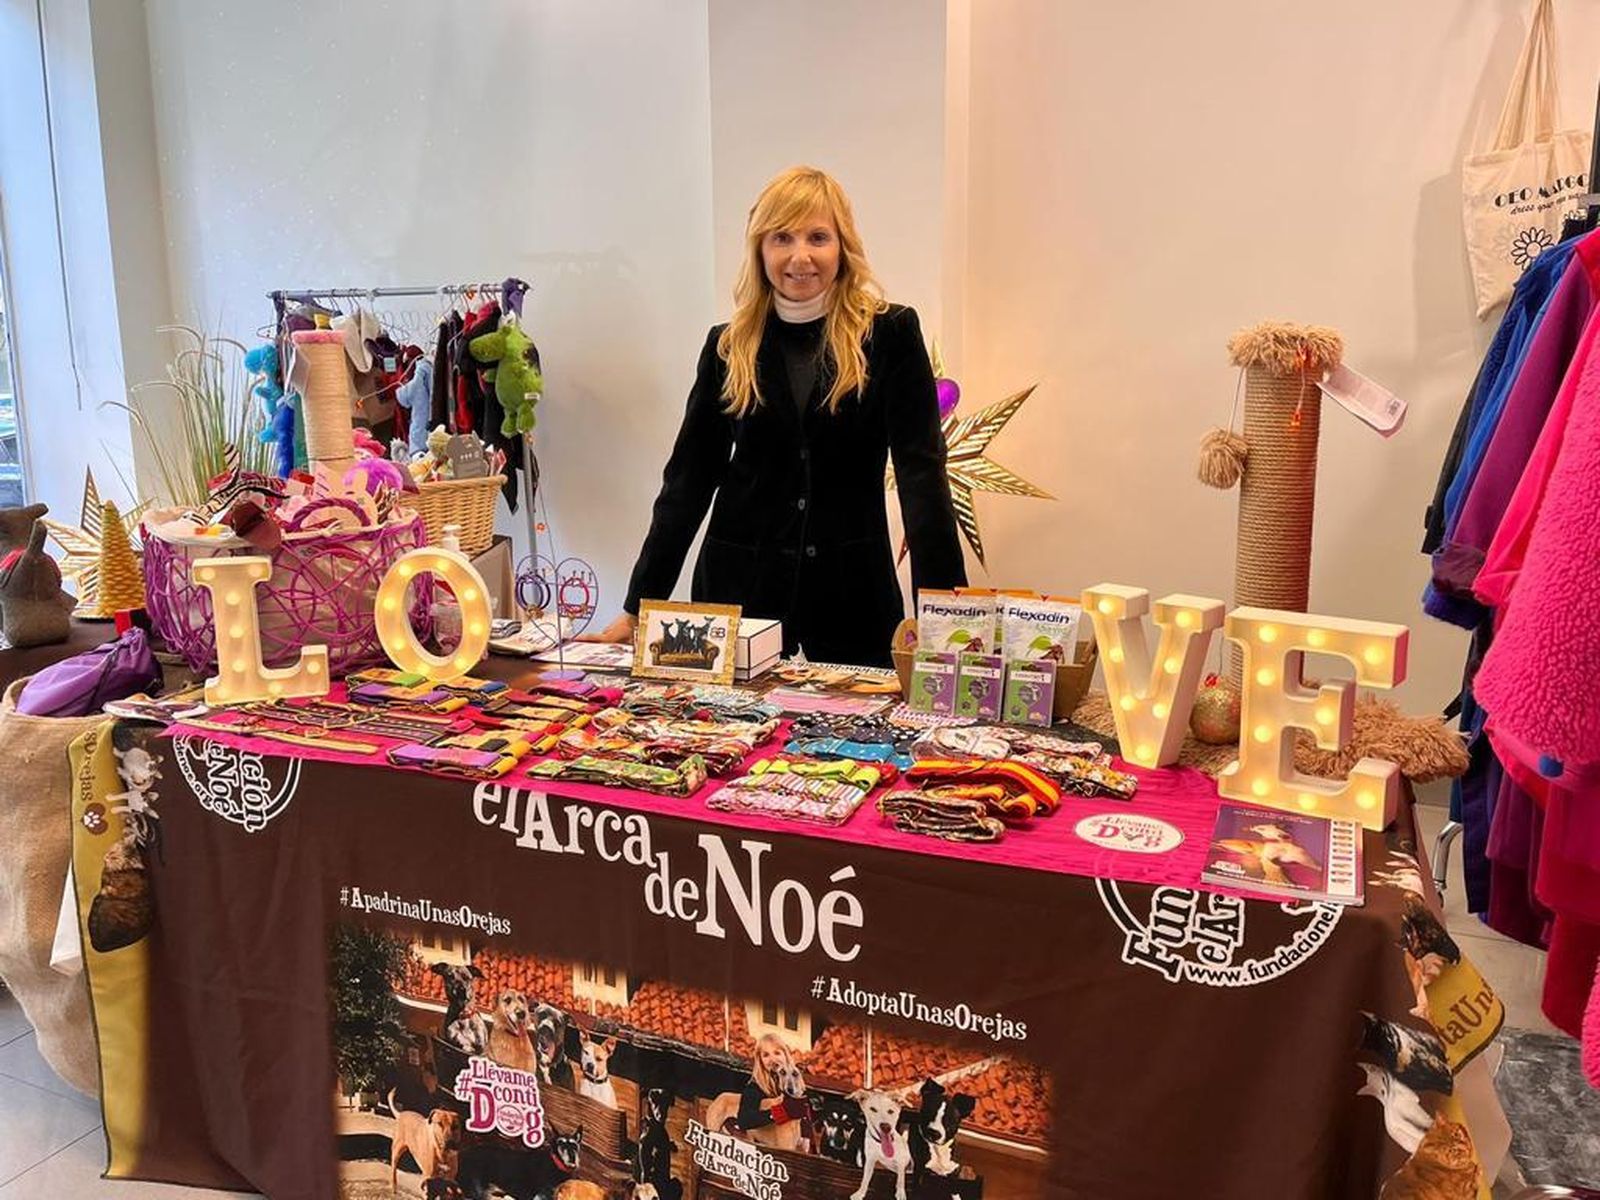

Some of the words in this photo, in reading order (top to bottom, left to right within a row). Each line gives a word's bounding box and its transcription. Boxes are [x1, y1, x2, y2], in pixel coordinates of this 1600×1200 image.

[922, 603, 987, 618] Flexadin
[1008, 607, 1070, 625] Flexadin
[81, 731, 98, 801] sOrejas
[340, 886, 512, 936] #ApadrinaUnasOrejas
[1127, 889, 1197, 978] Fun
[1192, 894, 1241, 964] elAr
[811, 976, 1028, 1041] #AdoptaUnasOrejas
[1440, 979, 1494, 1047] taUn
[687, 1121, 788, 1180] Fundación
